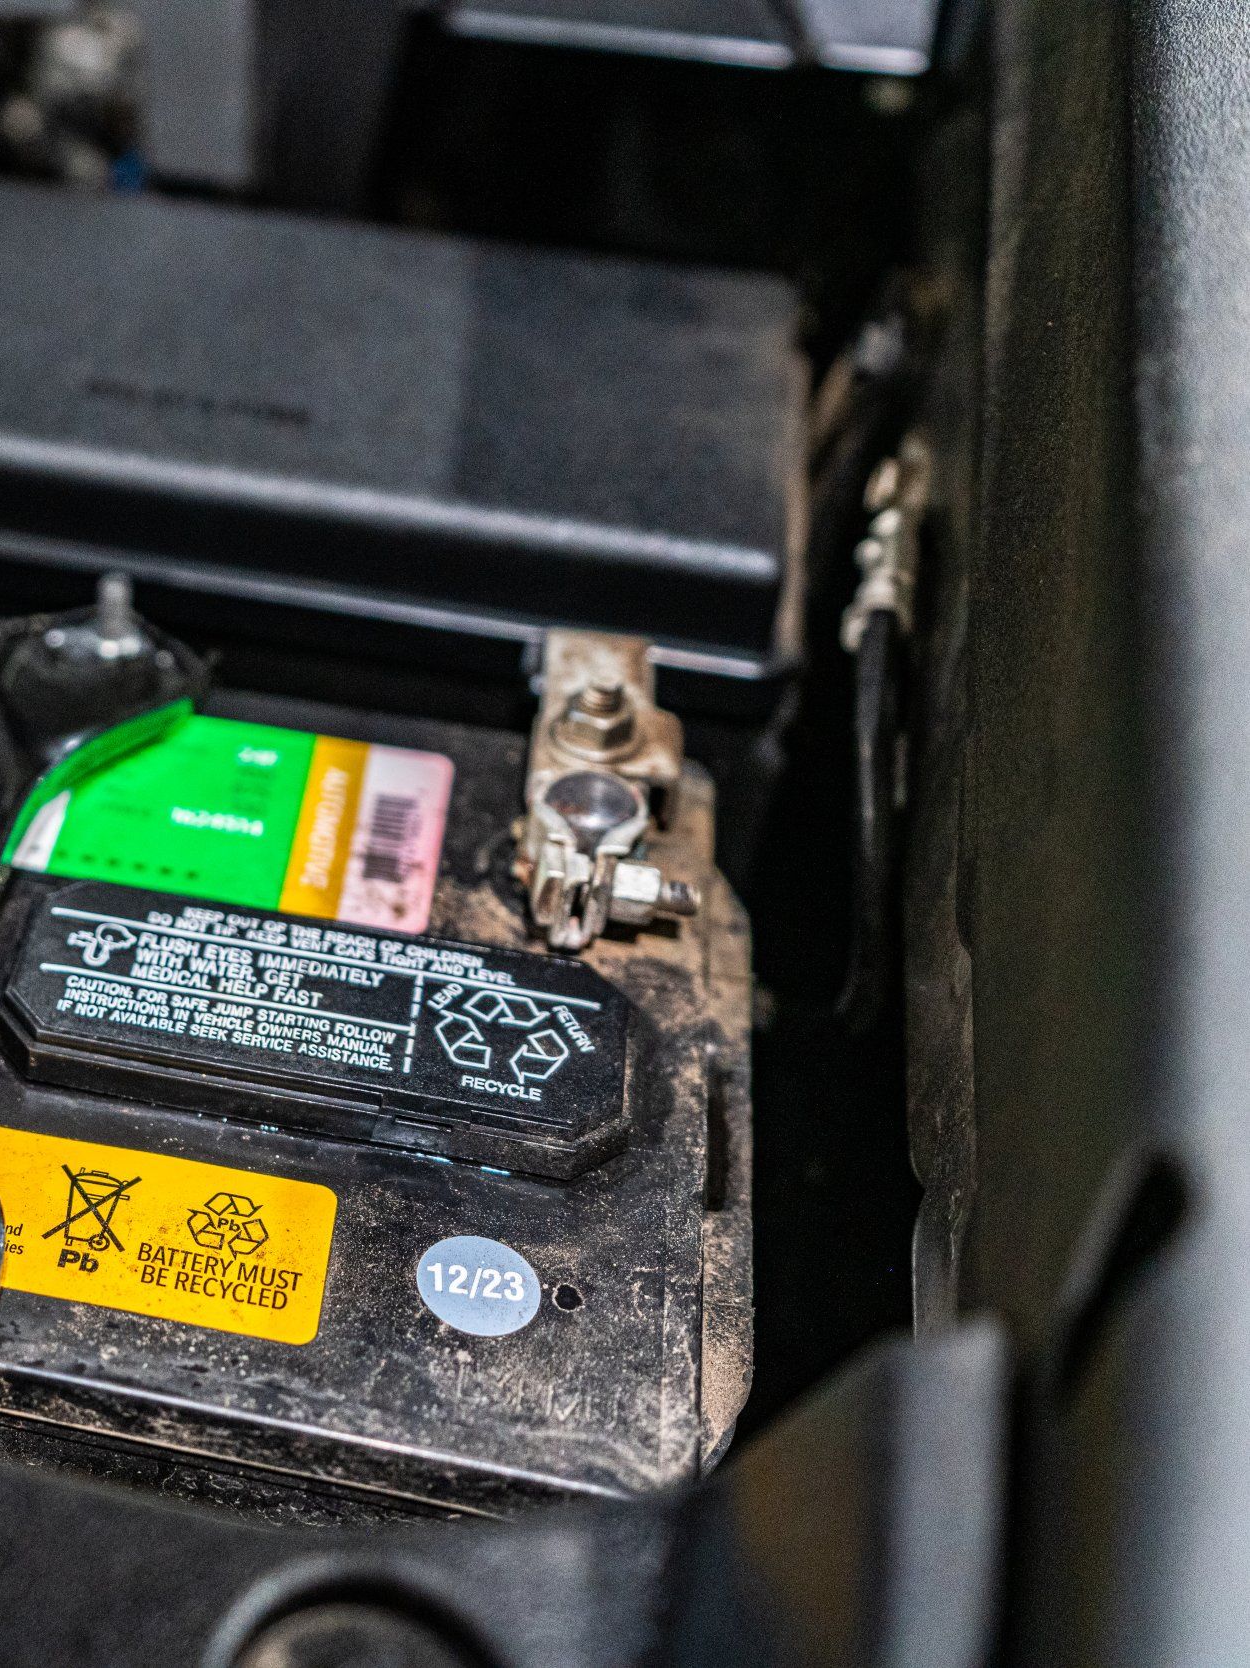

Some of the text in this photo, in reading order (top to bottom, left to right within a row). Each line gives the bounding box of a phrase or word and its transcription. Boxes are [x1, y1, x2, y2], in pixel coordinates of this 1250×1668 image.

[137, 932, 385, 988] FLUSH EYES IMMEDIATELY
[147, 911, 173, 926] DO
[174, 917, 208, 933] NOT
[245, 928, 287, 944] KEEP
[289, 935, 331, 952] VENT
[334, 944, 377, 962] CAPS
[380, 951, 429, 970] TIGHT
[429, 960, 465, 977] AND
[467, 968, 516, 986] LEVEL
[182, 906, 484, 968] KEEP OUT OF THE REACH OF CHILDREN
[130, 963, 324, 1007] MEDICAL HELP FAST
[135, 947, 304, 988] WITH WATER. GET
[66, 975, 397, 1045] CAUTION: FOR SAFE JUMP STARTING FOLLOW
[427, 983, 463, 1010] LEAD
[56, 999, 393, 1071] IF NOT AVAILABLE SEEK SERVICE ASSISTANCE.
[64, 988, 391, 1057] INSTRUCTIONS IN VEHICLE OWNERS MANUAL.
[552, 1004, 595, 1052] RETURN
[461, 1075, 542, 1100] RECYCLE
[217, 1217, 240, 1232] Pb
[57, 1248, 99, 1273] Pb
[137, 1242, 303, 1291] BATTERY MUST
[427, 1262, 525, 1301] 12/23
[140, 1264, 288, 1310] BE RECYCLED
